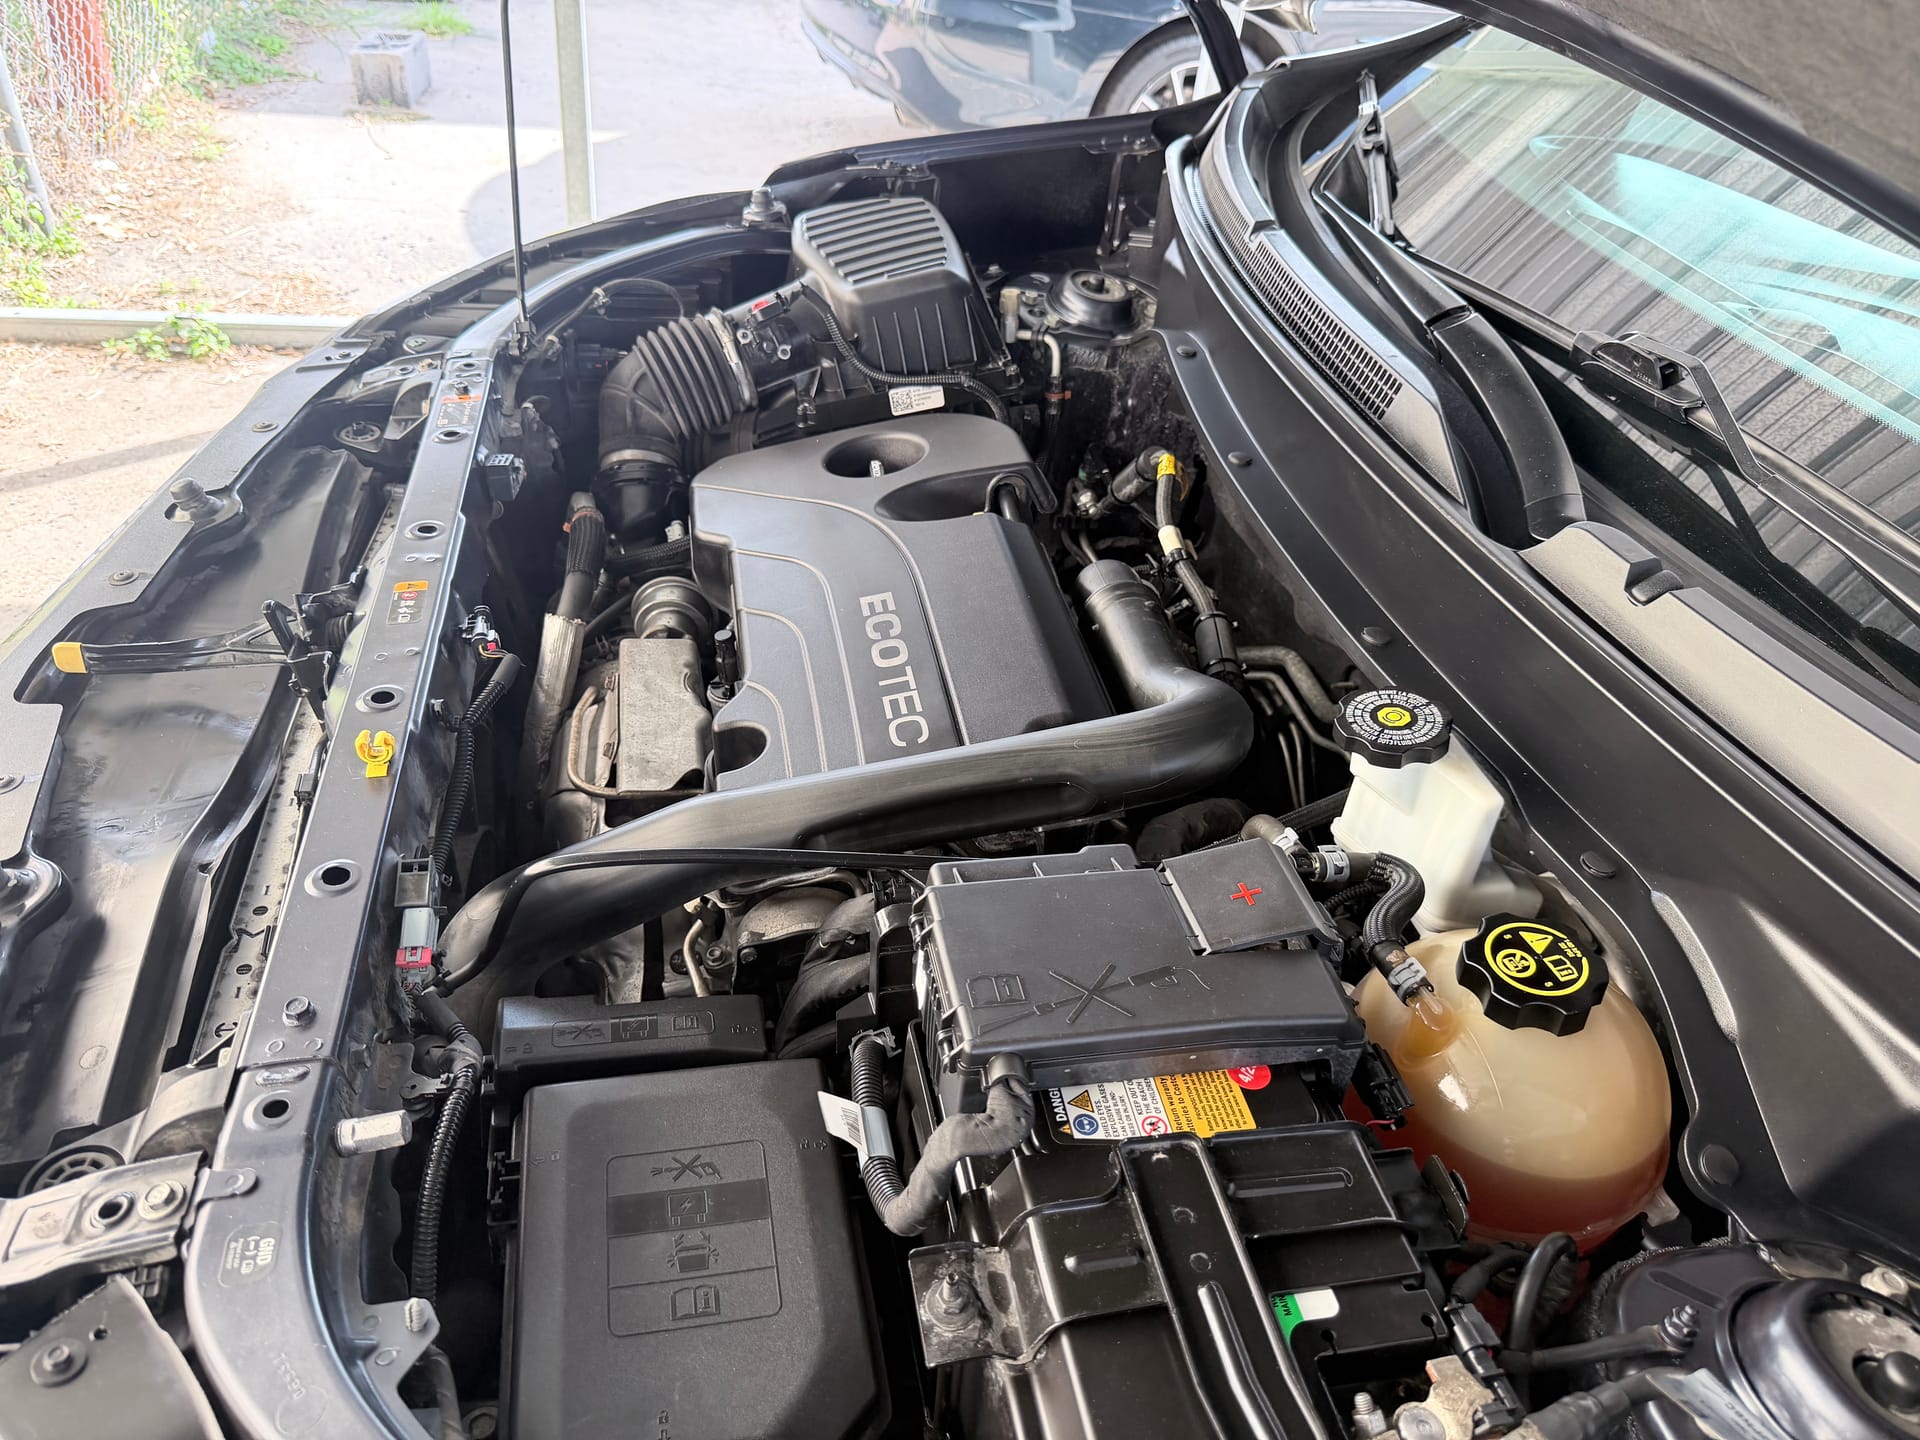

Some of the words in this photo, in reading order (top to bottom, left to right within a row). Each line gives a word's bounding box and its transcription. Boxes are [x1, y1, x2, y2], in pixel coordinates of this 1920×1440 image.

[859, 592, 929, 746] ECOTEC
[1137, 1082, 1147, 1101] REACH
[1160, 1078, 1176, 1106] warranty
[1186, 1086, 1203, 1120] PROPOSITION
[1115, 1108, 1123, 1124] CAUSE
[1134, 1100, 1143, 1115] KEEP
[1144, 1103, 1152, 1114] THE
[1170, 1108, 1183, 1130] Return
[1180, 1106, 1195, 1131] atteries
[1100, 1116, 1111, 1137] SHIELD
[1105, 1105, 1119, 1136] EXPLOSIVE
[256, 1238, 275, 1265] GND
